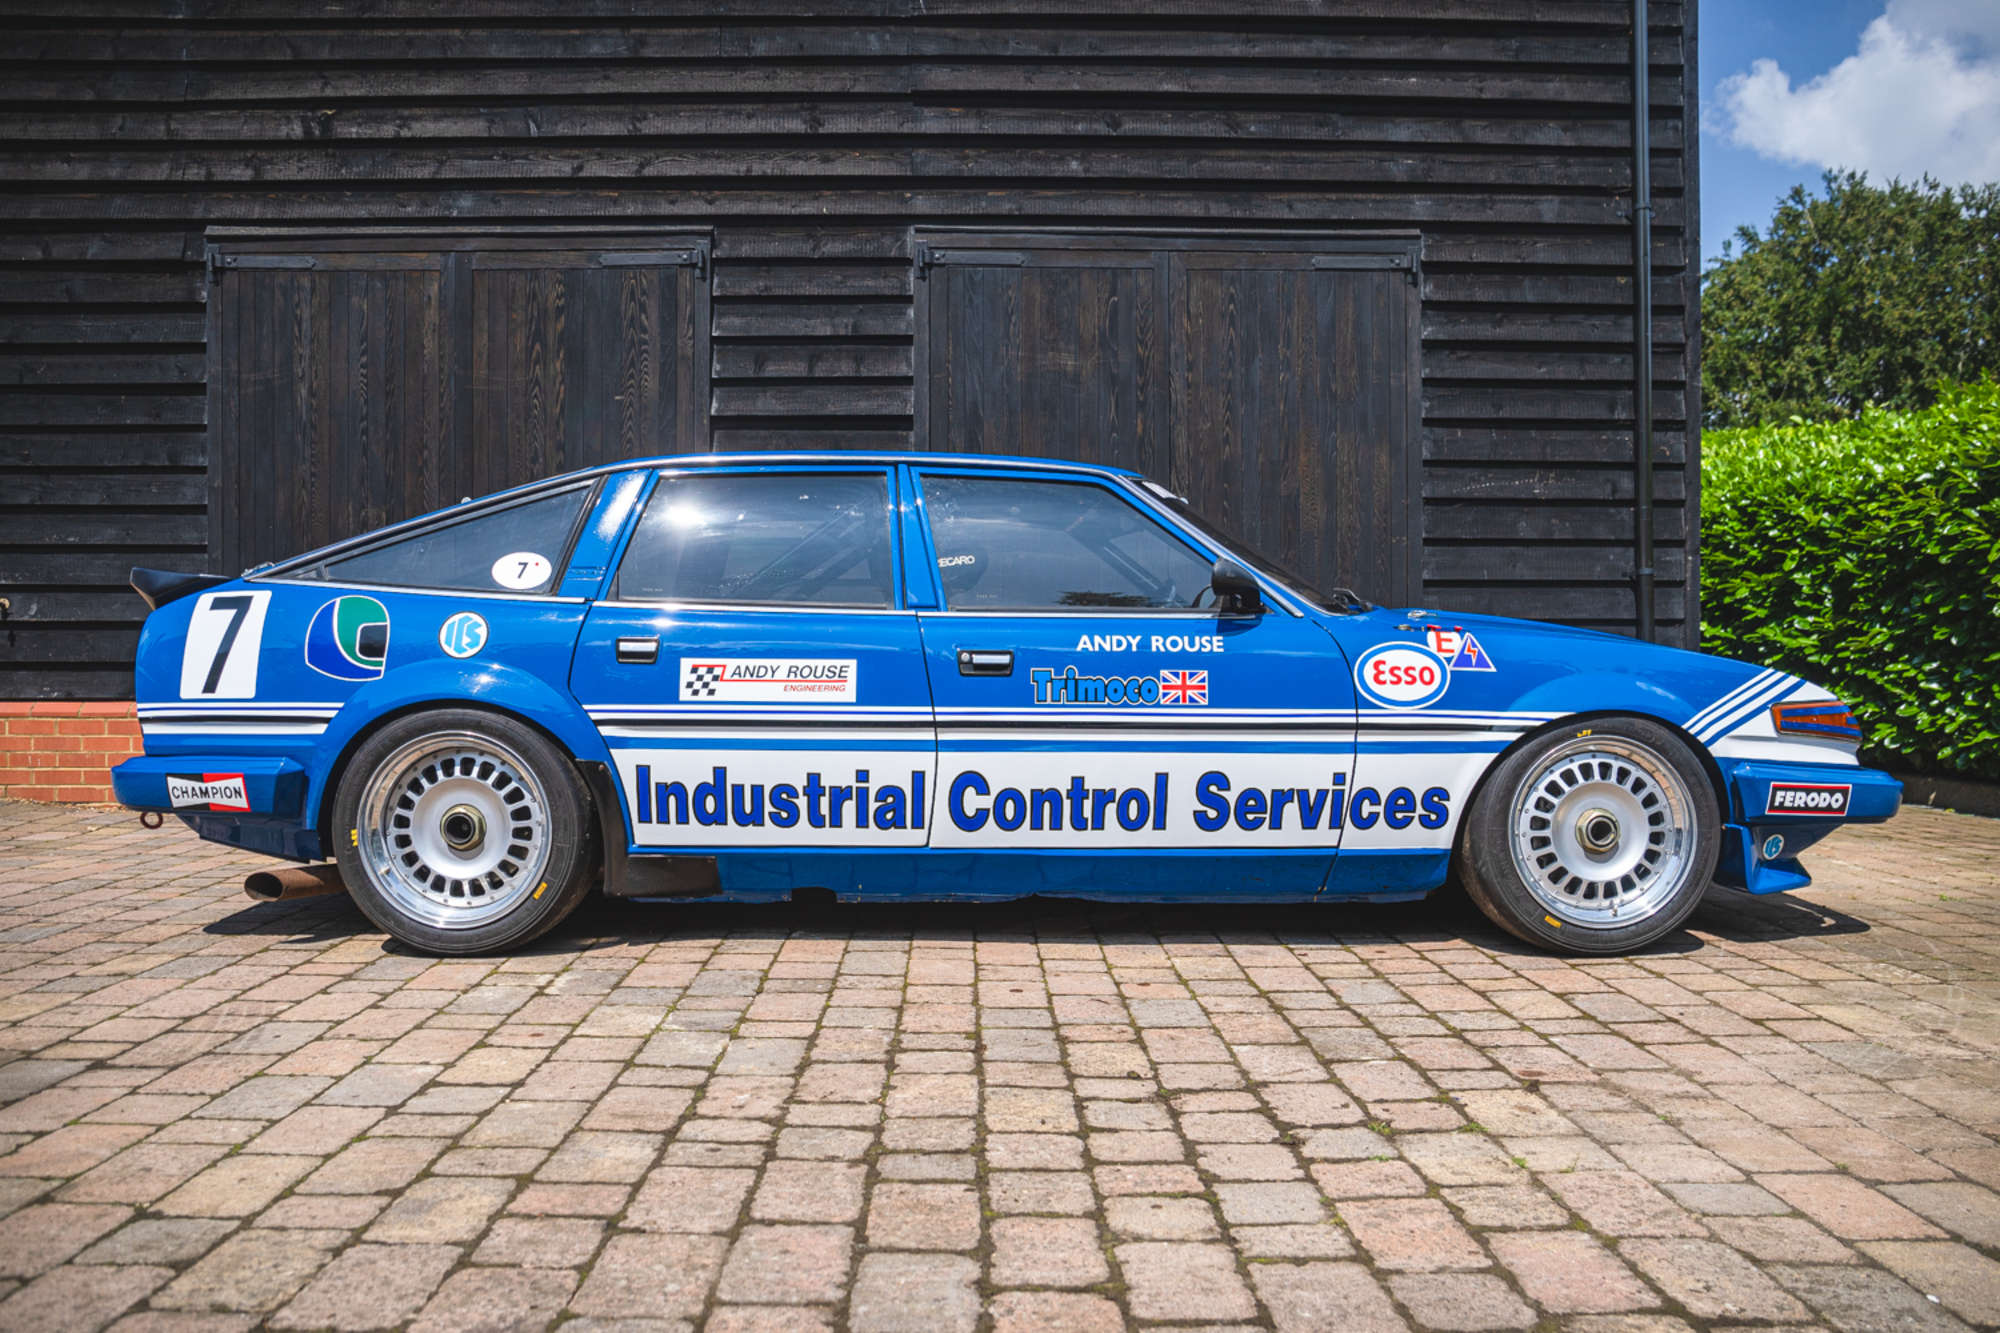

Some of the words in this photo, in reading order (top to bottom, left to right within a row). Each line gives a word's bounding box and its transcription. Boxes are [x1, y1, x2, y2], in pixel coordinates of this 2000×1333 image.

[517, 562, 529, 579] 7
[202, 595, 254, 694] 7
[1076, 634, 1142, 652] ANDY
[1150, 635, 1225, 653] ROUSE
[730, 664, 781, 679] ANDY
[786, 664, 850, 679] ROUSE
[783, 684, 846, 693] ENGINEERING
[1031, 665, 1160, 705] Trimoco
[171, 785, 243, 799] CHAMPION
[635, 764, 926, 830] Industrial
[948, 769, 1169, 833] Control
[1192, 770, 1451, 833] Services
[1773, 790, 1845, 809] FERODO
